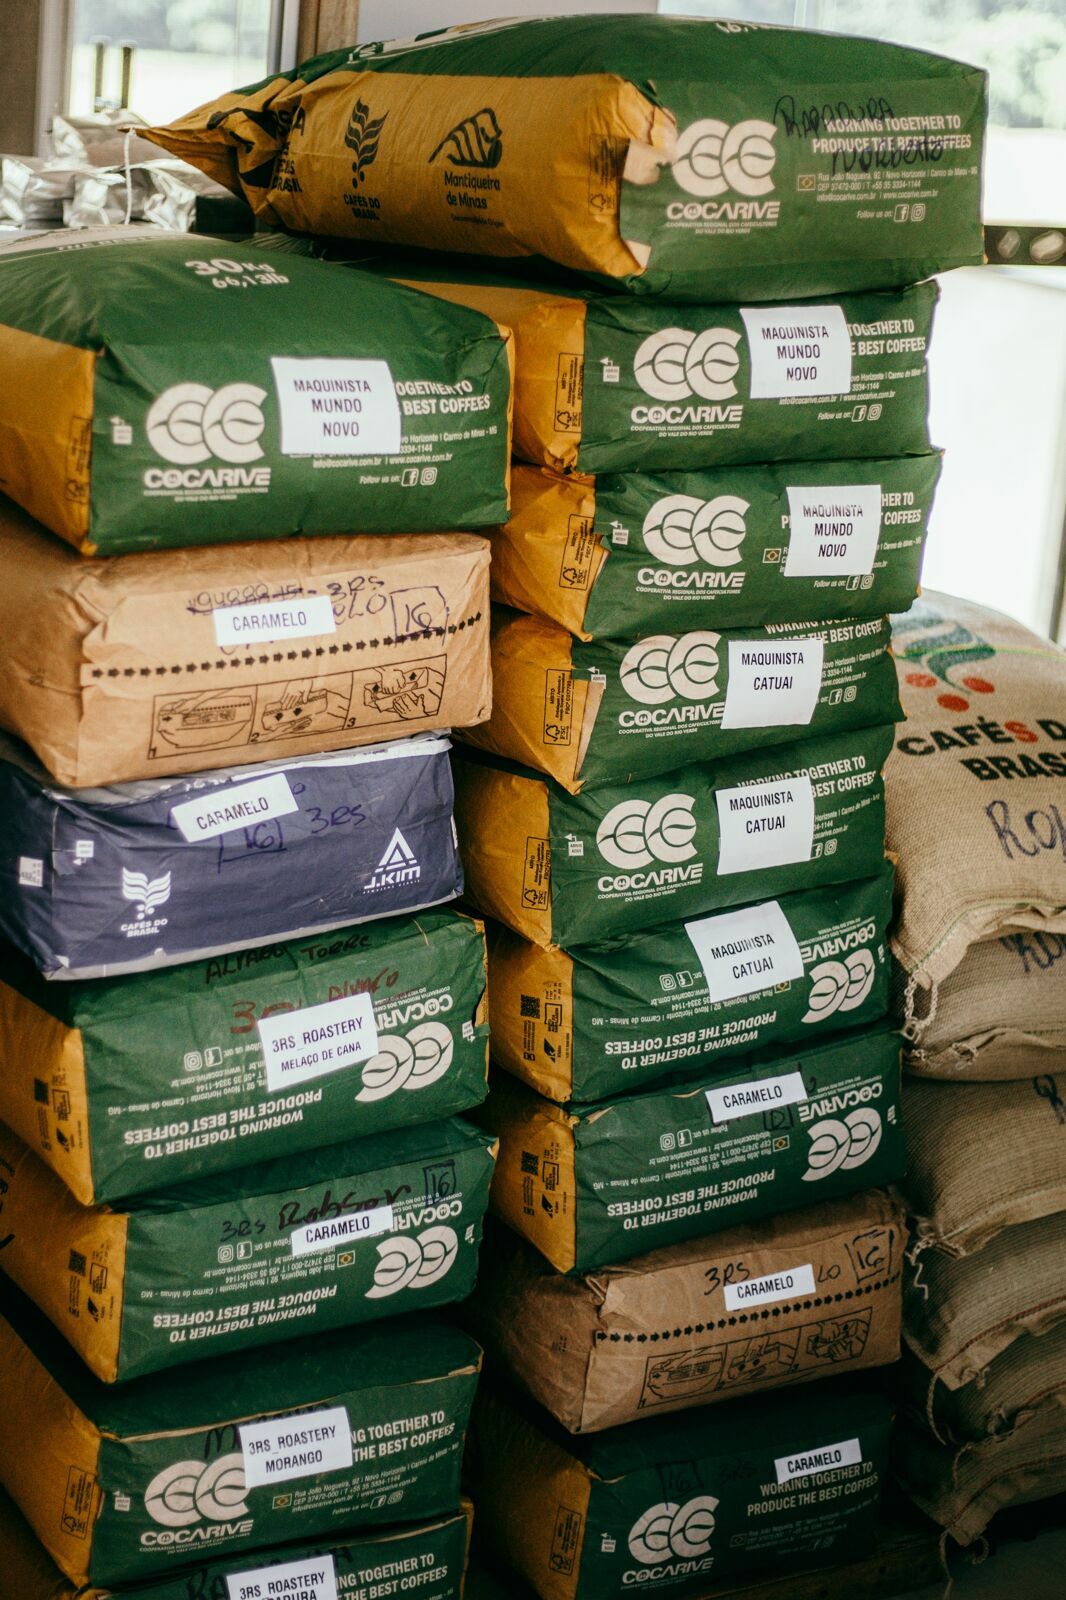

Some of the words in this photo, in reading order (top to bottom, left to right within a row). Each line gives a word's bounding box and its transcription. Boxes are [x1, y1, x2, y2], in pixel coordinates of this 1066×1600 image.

[884, 116, 946, 131] TOGETHER
[947, 115, 960, 129] TO
[813, 137, 869, 153] PRODUCE
[871, 137, 894, 152] THE
[897, 136, 924, 150] BEST
[927, 134, 971, 150] COFFEES
[444, 171, 500, 192] Mantiqueira
[446, 193, 458, 207] de
[459, 192, 487, 209] Minas
[666, 201, 780, 220] COCARIVE
[184, 257, 244, 276] 30
[762, 326, 829, 340] MAQUINISTA
[903, 319, 914, 334] TO
[777, 344, 820, 359] MUNDO
[859, 339, 885, 355] BEST
[887, 337, 926, 353] COFFEES
[786, 366, 817, 381] NOVO
[293, 379, 371, 394] MAQUINISTA
[455, 380, 473, 397] TO
[312, 399, 362, 413] MUNDO
[403, 400, 437, 416] BEST
[440, 394, 490, 413] COFFEES
[630, 405, 743, 424] COCARIVE
[323, 422, 359, 437] NOVO
[144, 467, 271, 488] COCARIVE
[903, 492, 913, 505] TO
[803, 505, 863, 518] MAQUINISTA
[884, 509, 921, 525] COFFEES
[815, 523, 853, 537] MUNDO
[818, 544, 847, 557] NOVO
[637, 567, 746, 588] COCARIVE
[232, 611, 307, 632] CARAMELO
[830, 628, 853, 643] BEST
[741, 652, 804, 665] MAQUINISTA
[753, 676, 793, 690] CATUAI
[618, 702, 725, 727] COCARIVE
[618, 727, 653, 735] COOPERATIVA
[654, 725, 677, 733] REGIONAL
[896, 716, 1039, 756] CAFÉS
[794, 760, 851, 780] TOGETHER
[852, 755, 866, 770] TO
[812, 781, 836, 798] BEST
[837, 770, 876, 792] COFFEES
[729, 791, 793, 811] MAQUINISTA
[195, 796, 270, 831] CARAMELO
[746, 815, 786, 834] CATUAI
[598, 863, 703, 893] COCARIVE
[598, 891, 632, 900] COOPERATIVA
[633, 889, 656, 897] REGIONAL
[126, 926, 160, 938] BRASIL
[154, 918, 168, 928] DO
[711, 933, 775, 959] MAQUINISTA
[800, 922, 876, 964] COCARIVE
[732, 956, 774, 979] CATUAI
[610, 1016, 629, 1024] Minas
[631, 1016, 639, 1024] de
[640, 1014, 661, 1023] Carmo
[723, 1010, 776, 1032] PRODUCE
[664, 1030, 695, 1047] BEST
[699, 1026, 720, 1040] THE
[704, 1030, 758, 1051] WORKING
[605, 1037, 662, 1055] COFFEES
[641, 1045, 701, 1066] TOGETHER
[281, 1052, 319, 1072] MELAÇO
[322, 1049, 334, 1061] DE
[337, 1041, 361, 1056] CANA
[622, 1057, 637, 1070] TO
[260, 1088, 323, 1114] PRODUCE
[723, 1085, 782, 1109] CARAMELO
[799, 1082, 883, 1123] COCARIVE
[192, 1113, 227, 1133] BEST
[230, 1106, 256, 1122] THE
[240, 1109, 304, 1135] WORKING
[124, 1123, 189, 1145] COFFEES
[166, 1128, 237, 1154] TOGETHER
[144, 1145, 163, 1160] TO
[722, 1169, 776, 1193] PRODUCE
[664, 1191, 695, 1207] BEST
[698, 1186, 719, 1200] THE
[704, 1188, 758, 1212] WORKING
[607, 1197, 662, 1216] COFFEES
[641, 1205, 701, 1226] TOGETHER
[306, 1216, 371, 1244] CARAMELO
[623, 1218, 638, 1230] TO
[323, 1255, 336, 1265] CEP
[323, 1263, 335, 1271] Rua
[192, 1287, 214, 1296] Carmo
[278, 1284, 337, 1307] PRODUCE
[736, 1275, 794, 1300] CARAMELO
[216, 1303, 250, 1321] BEST
[252, 1300, 275, 1314] THE
[258, 1303, 317, 1326] WORKING
[153, 1310, 214, 1328] COFFEES
[169, 1330, 187, 1343] TO
[189, 1318, 254, 1341] TOGETHER
[368, 1414, 428, 1440] TOGETHER
[431, 1410, 445, 1424] TO
[353, 1445, 376, 1462] THE
[378, 1438, 409, 1456] BEST
[410, 1422, 455, 1449] COFFEES
[265, 1450, 323, 1474] MORANGO
[787, 1450, 842, 1473] CARAMELO
[760, 1477, 809, 1497] WORKING
[811, 1465, 860, 1486] TOGETHER
[861, 1461, 873, 1473] TO
[747, 1496, 796, 1516] PRODUCE
[798, 1491, 817, 1505] THE
[819, 1485, 844, 1501] BEST
[844, 1473, 878, 1495] COFFEES
[140, 1520, 254, 1546] COCARIVE
[358, 1560, 419, 1583] TOGETHER
[420, 1553, 435, 1567] TO
[622, 1557, 715, 1584] COCARIVE
[267, 1571, 325, 1595] ROASTERY
[369, 1582, 399, 1599] BEST
[401, 1565, 448, 1590] COFFEES
